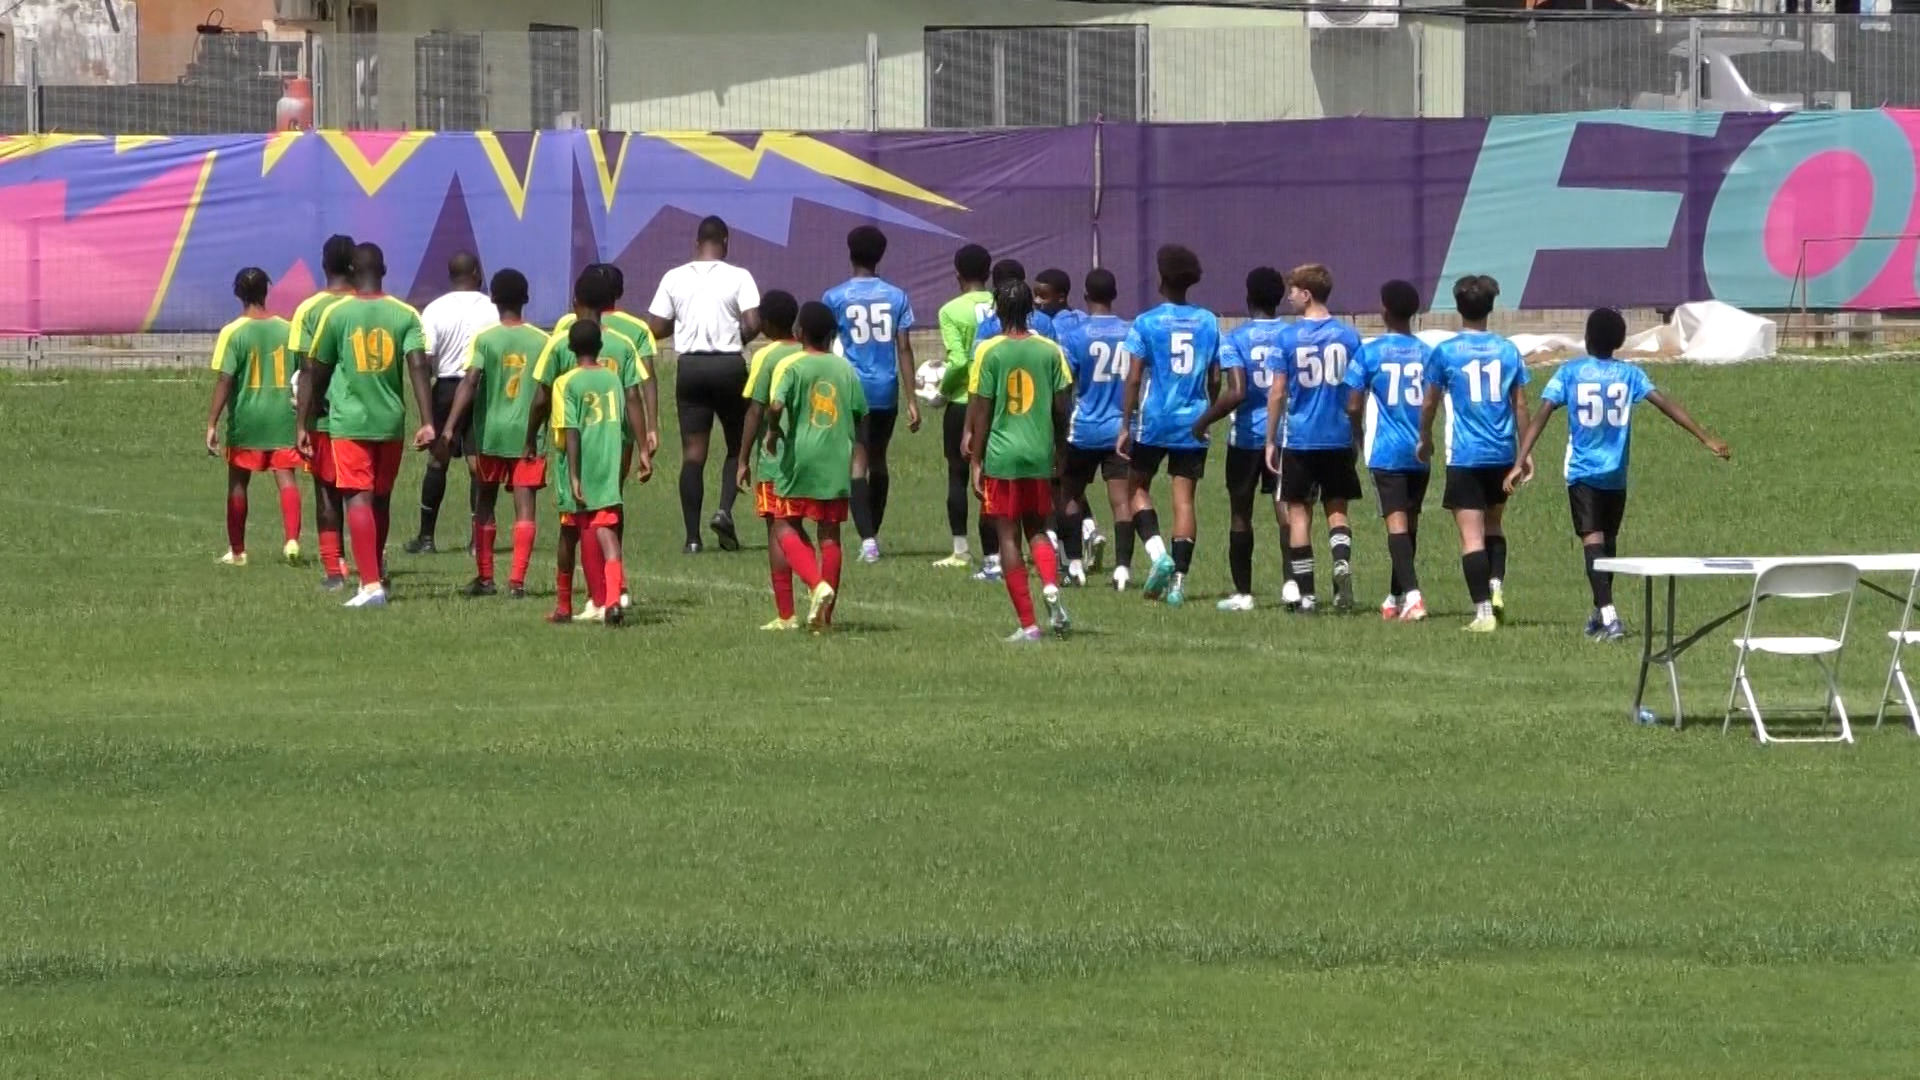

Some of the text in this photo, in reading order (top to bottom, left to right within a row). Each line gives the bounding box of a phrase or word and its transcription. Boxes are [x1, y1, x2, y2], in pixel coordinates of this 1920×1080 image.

[1428, 109, 1920, 311] FO
[846, 303, 892, 344] 35
[248, 346, 286, 388] 11
[352, 328, 395, 372] 19
[1089, 341, 1130, 382] 24
[1171, 332, 1194, 374] 5
[1296, 343, 1347, 388] 50
[502, 354, 527, 399] 7
[1008, 369, 1035, 415] 9
[1381, 362, 1423, 406] 73
[1462, 359, 1503, 403] 11
[583, 391, 617, 425] 31
[809, 381, 838, 429] 8
[1577, 382, 1629, 428] 53
